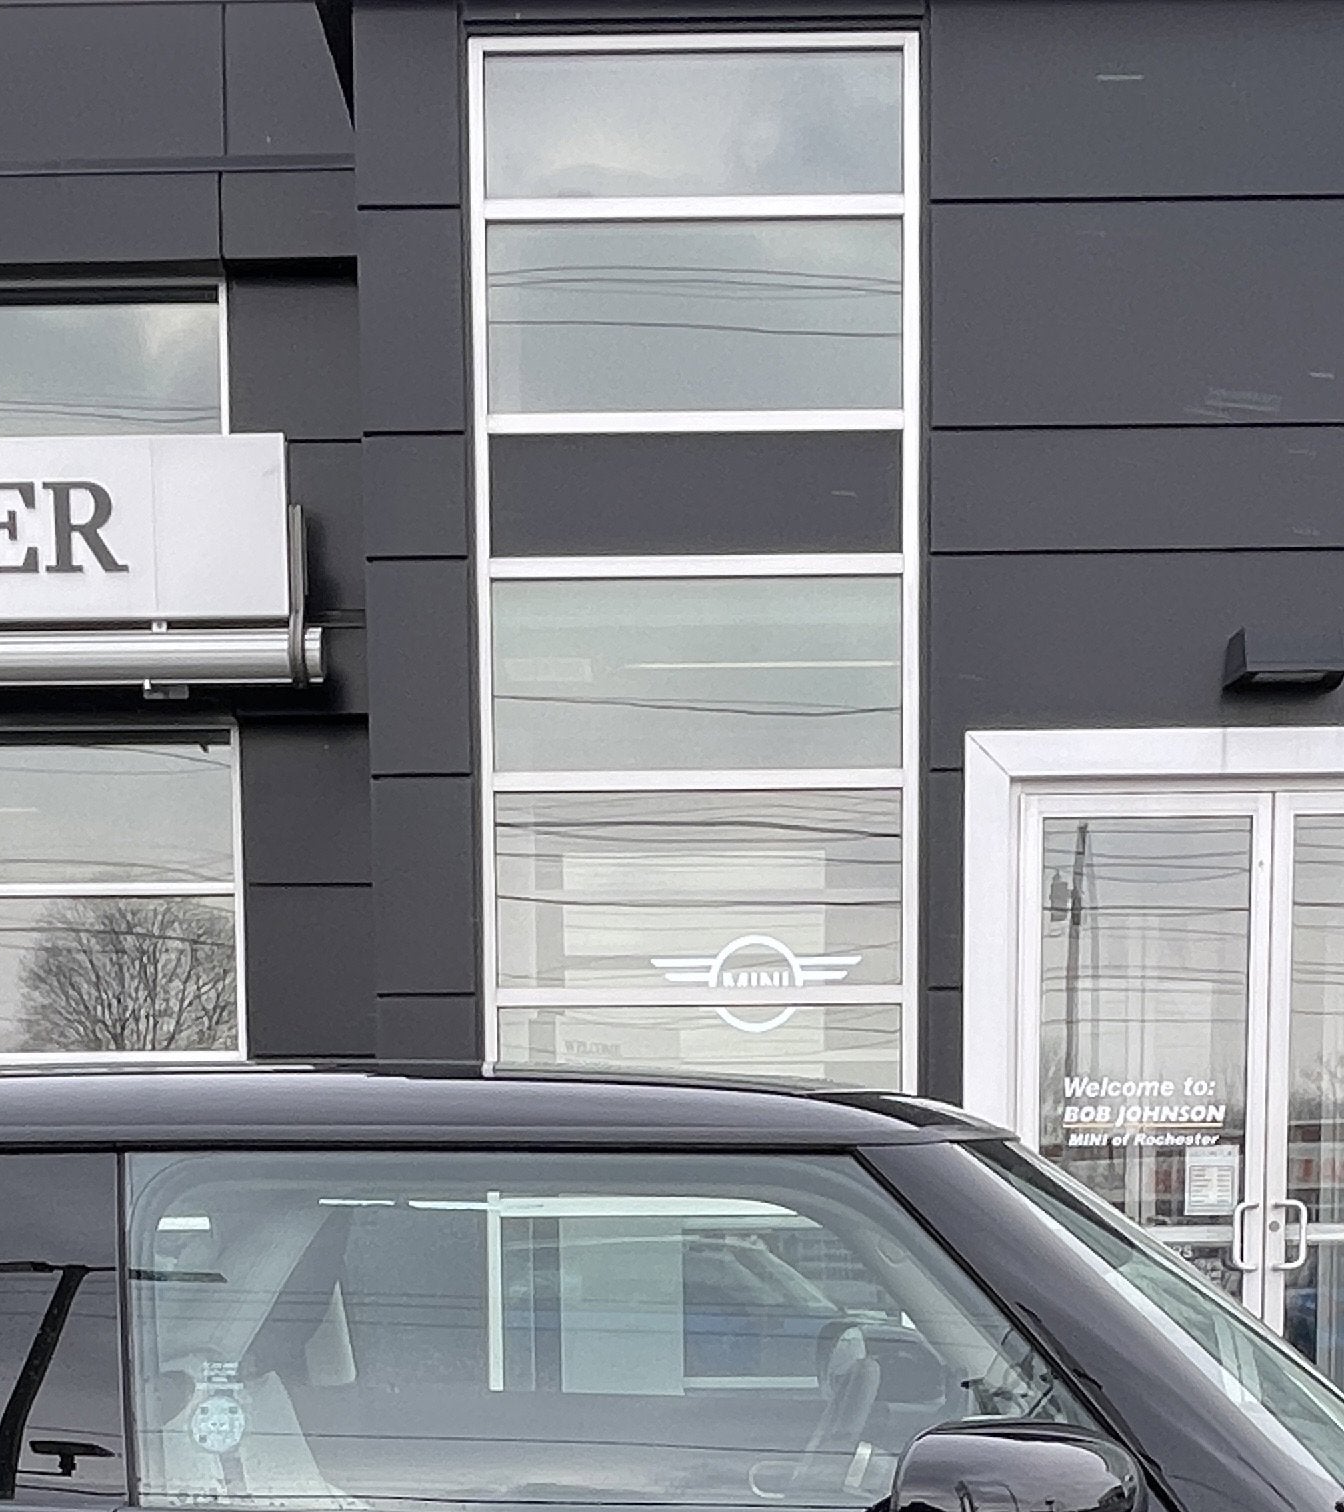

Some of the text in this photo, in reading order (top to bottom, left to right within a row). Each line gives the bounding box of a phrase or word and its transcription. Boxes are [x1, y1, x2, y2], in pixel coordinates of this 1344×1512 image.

[722, 970, 790, 988] MINI
[1063, 1076, 1216, 1098] Welcome to:
[1064, 1104, 1227, 1127] BOB JOHNSON
[1068, 1132, 1220, 1146] MINI of Rochester
